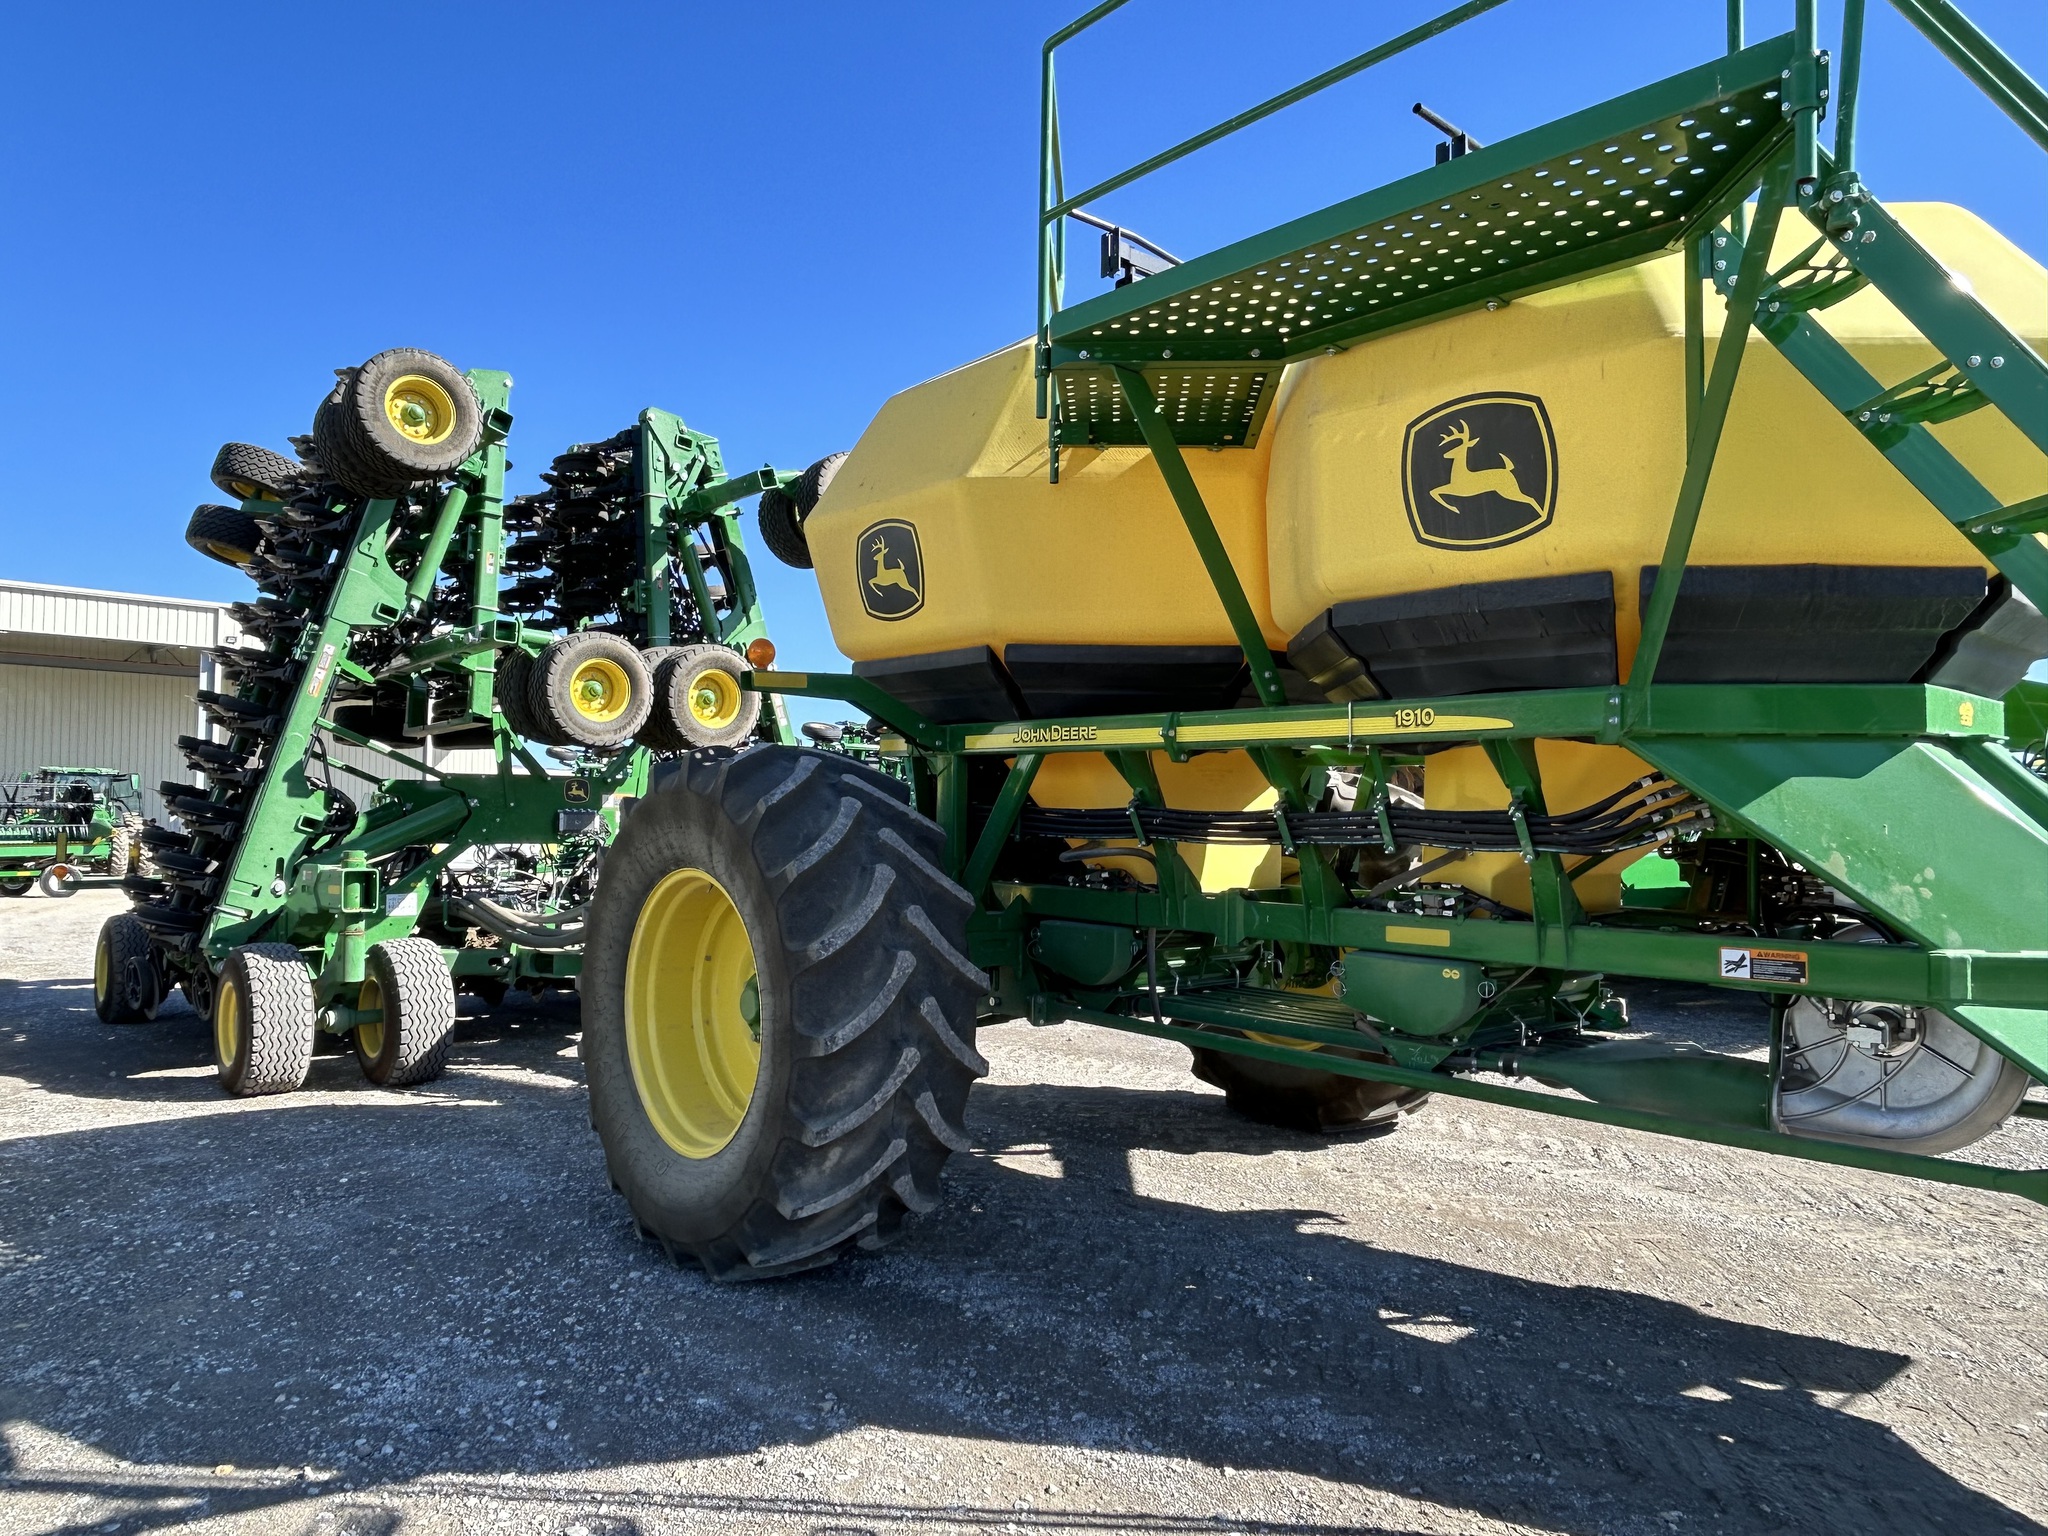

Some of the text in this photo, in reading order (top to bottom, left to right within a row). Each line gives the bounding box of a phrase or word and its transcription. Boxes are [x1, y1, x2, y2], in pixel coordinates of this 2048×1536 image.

[1395, 707, 1435, 727] 1910
[1012, 725, 1098, 743] JOHN DEERE
[1763, 951, 1800, 960] WARNING
